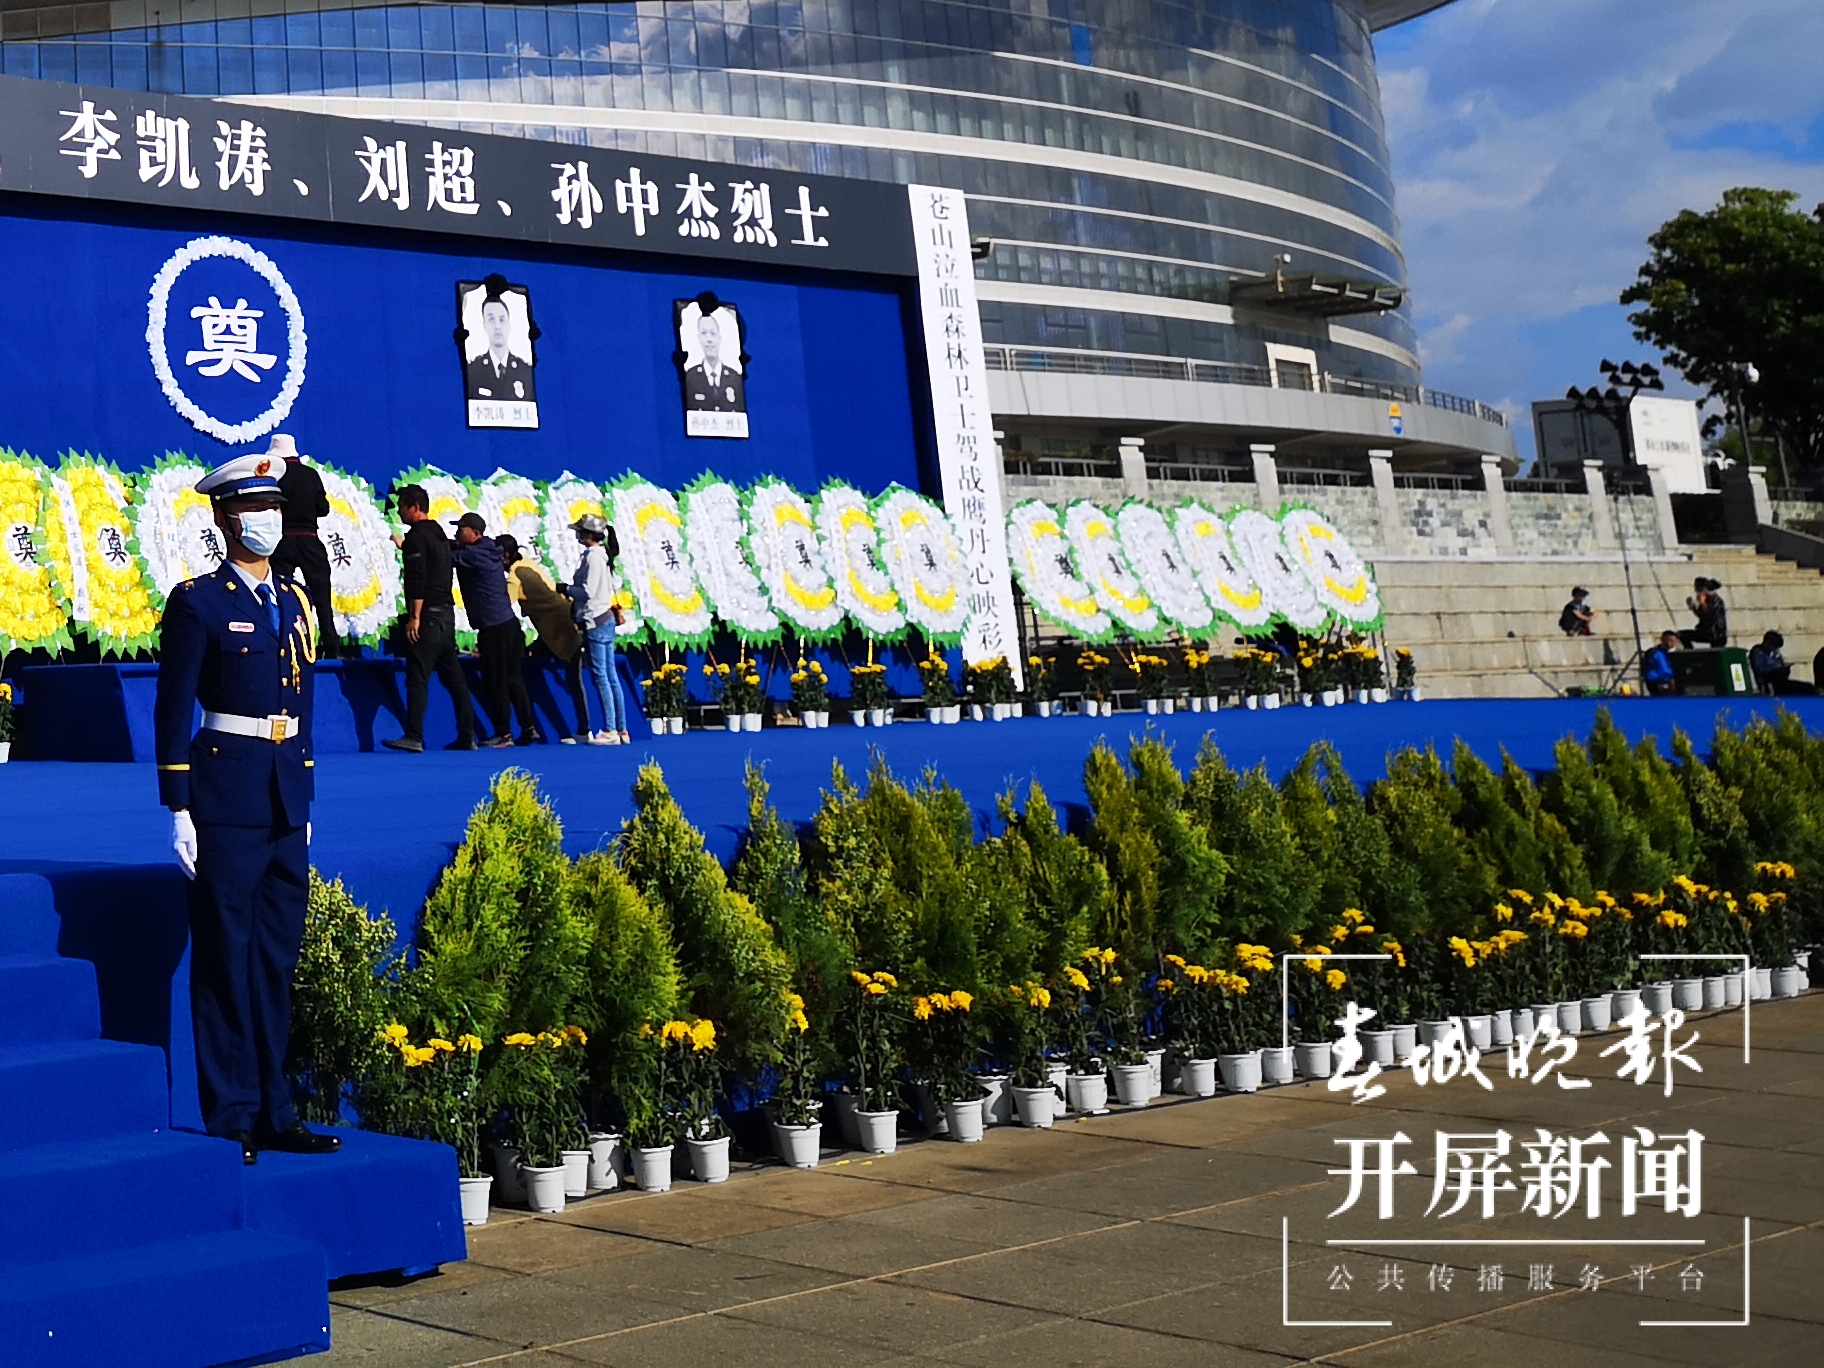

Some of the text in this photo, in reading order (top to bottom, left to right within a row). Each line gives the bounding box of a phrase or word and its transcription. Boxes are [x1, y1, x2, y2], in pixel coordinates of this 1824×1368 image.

[185, 296, 278, 383] 奠
[12, 525, 38, 564] 奠
[98, 527, 127, 563] 奠
[200, 527, 224, 562] 奠
[327, 532, 352, 568] 奠
